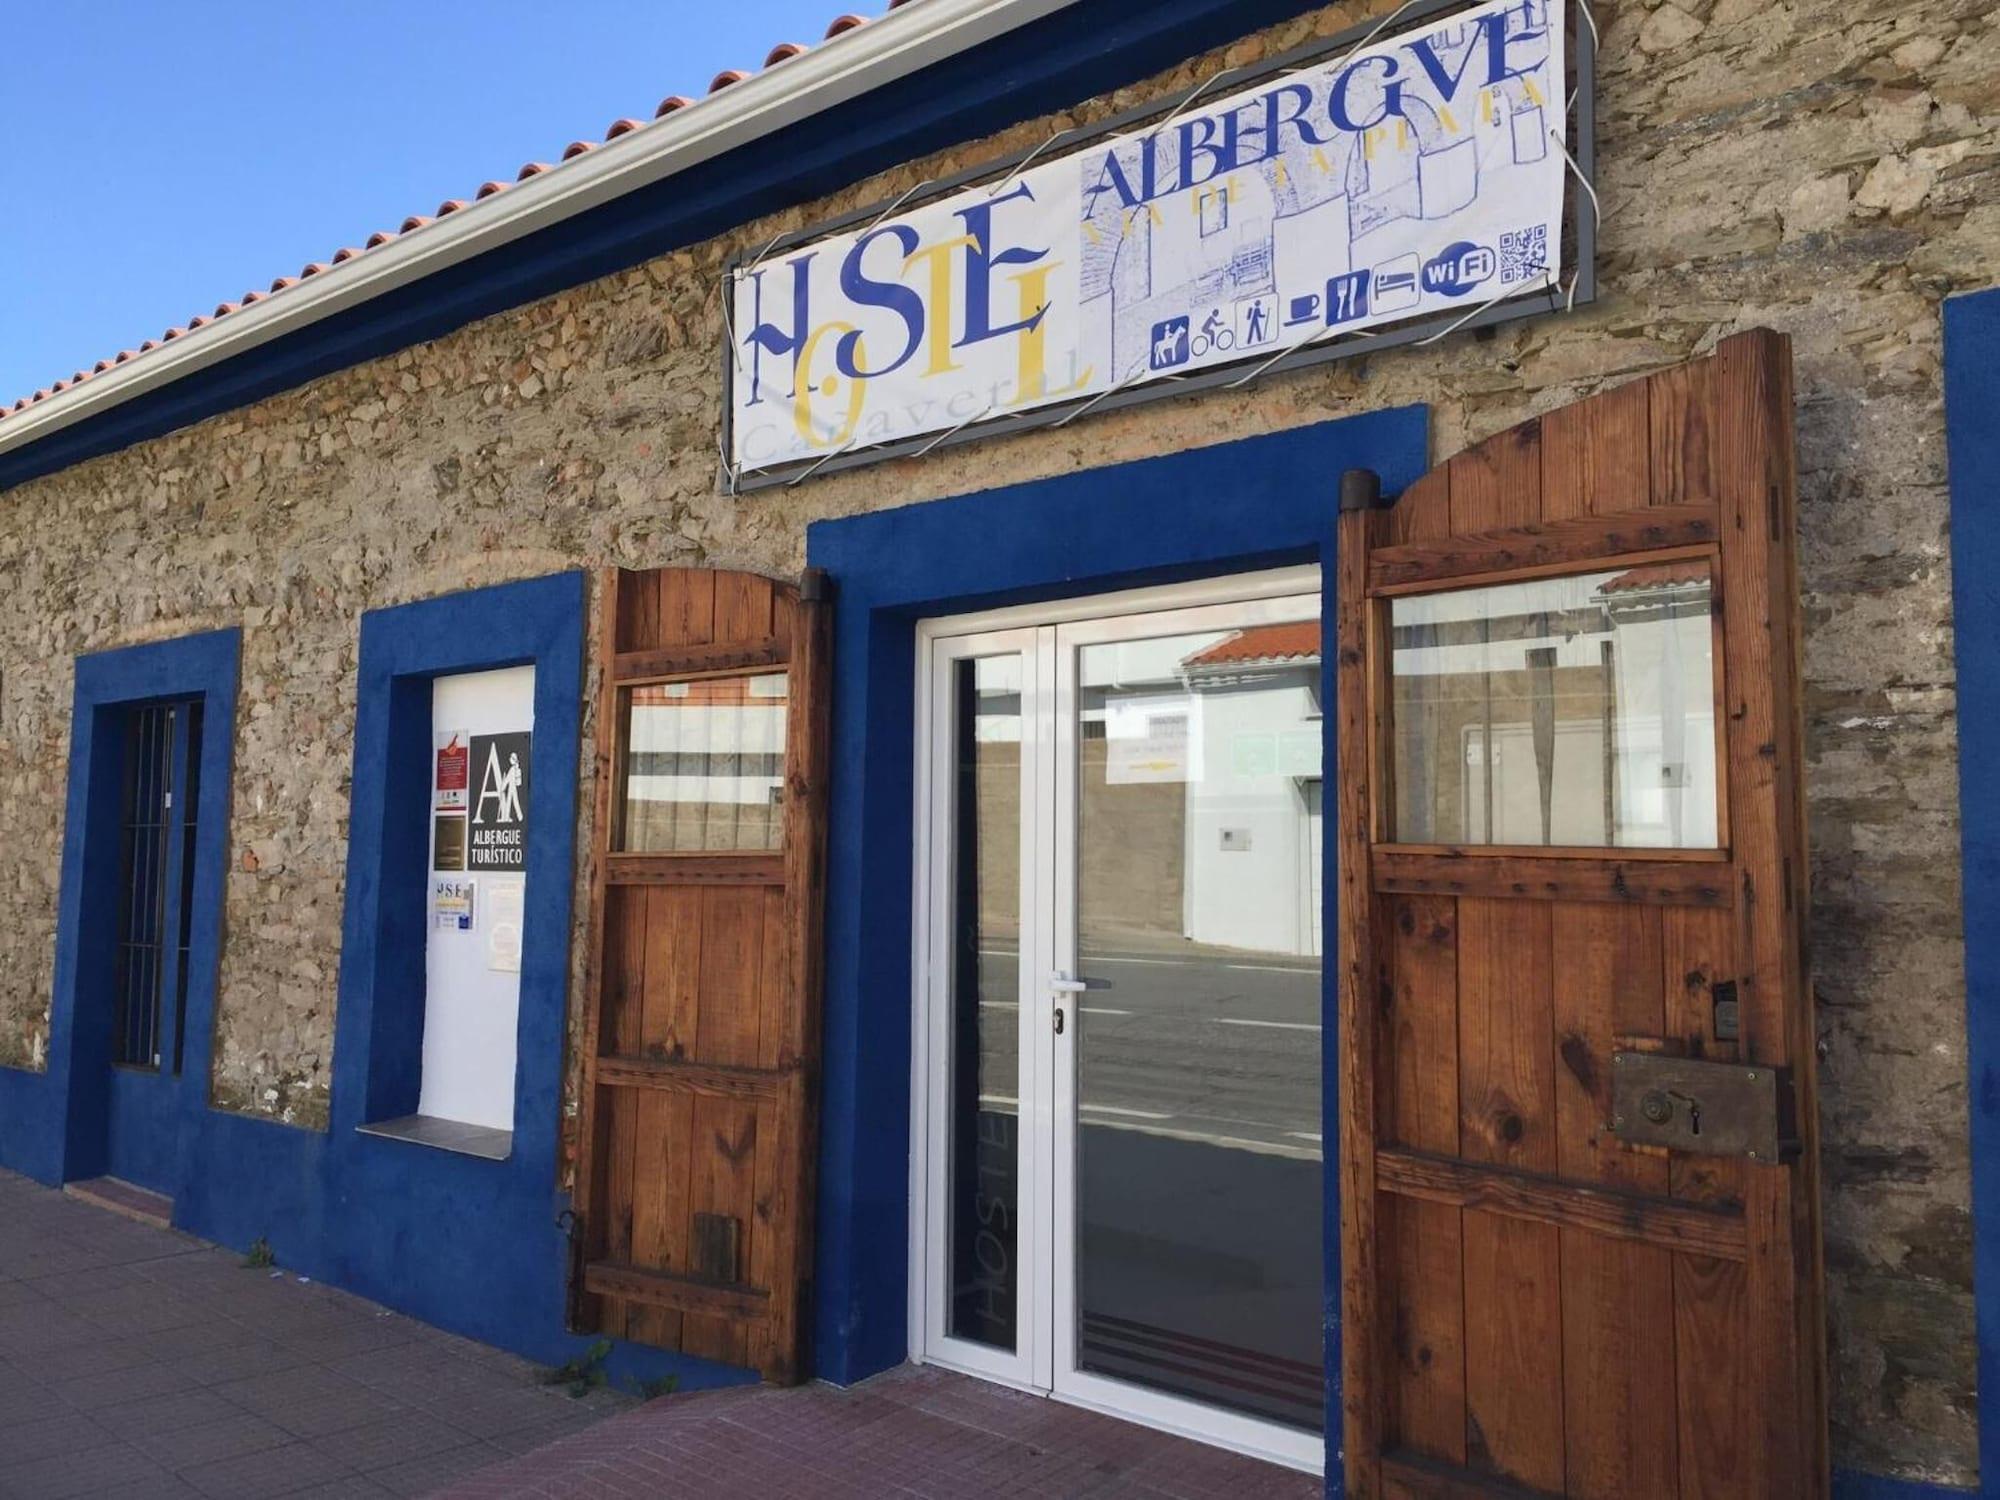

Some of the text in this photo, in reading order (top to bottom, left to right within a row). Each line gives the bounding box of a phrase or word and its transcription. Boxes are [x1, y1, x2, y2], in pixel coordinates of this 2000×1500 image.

[743, 180, 1093, 448] HOSTEL
[473, 829, 521, 845] ALBERGUE
[471, 845, 523, 864] TURÍSTICO
